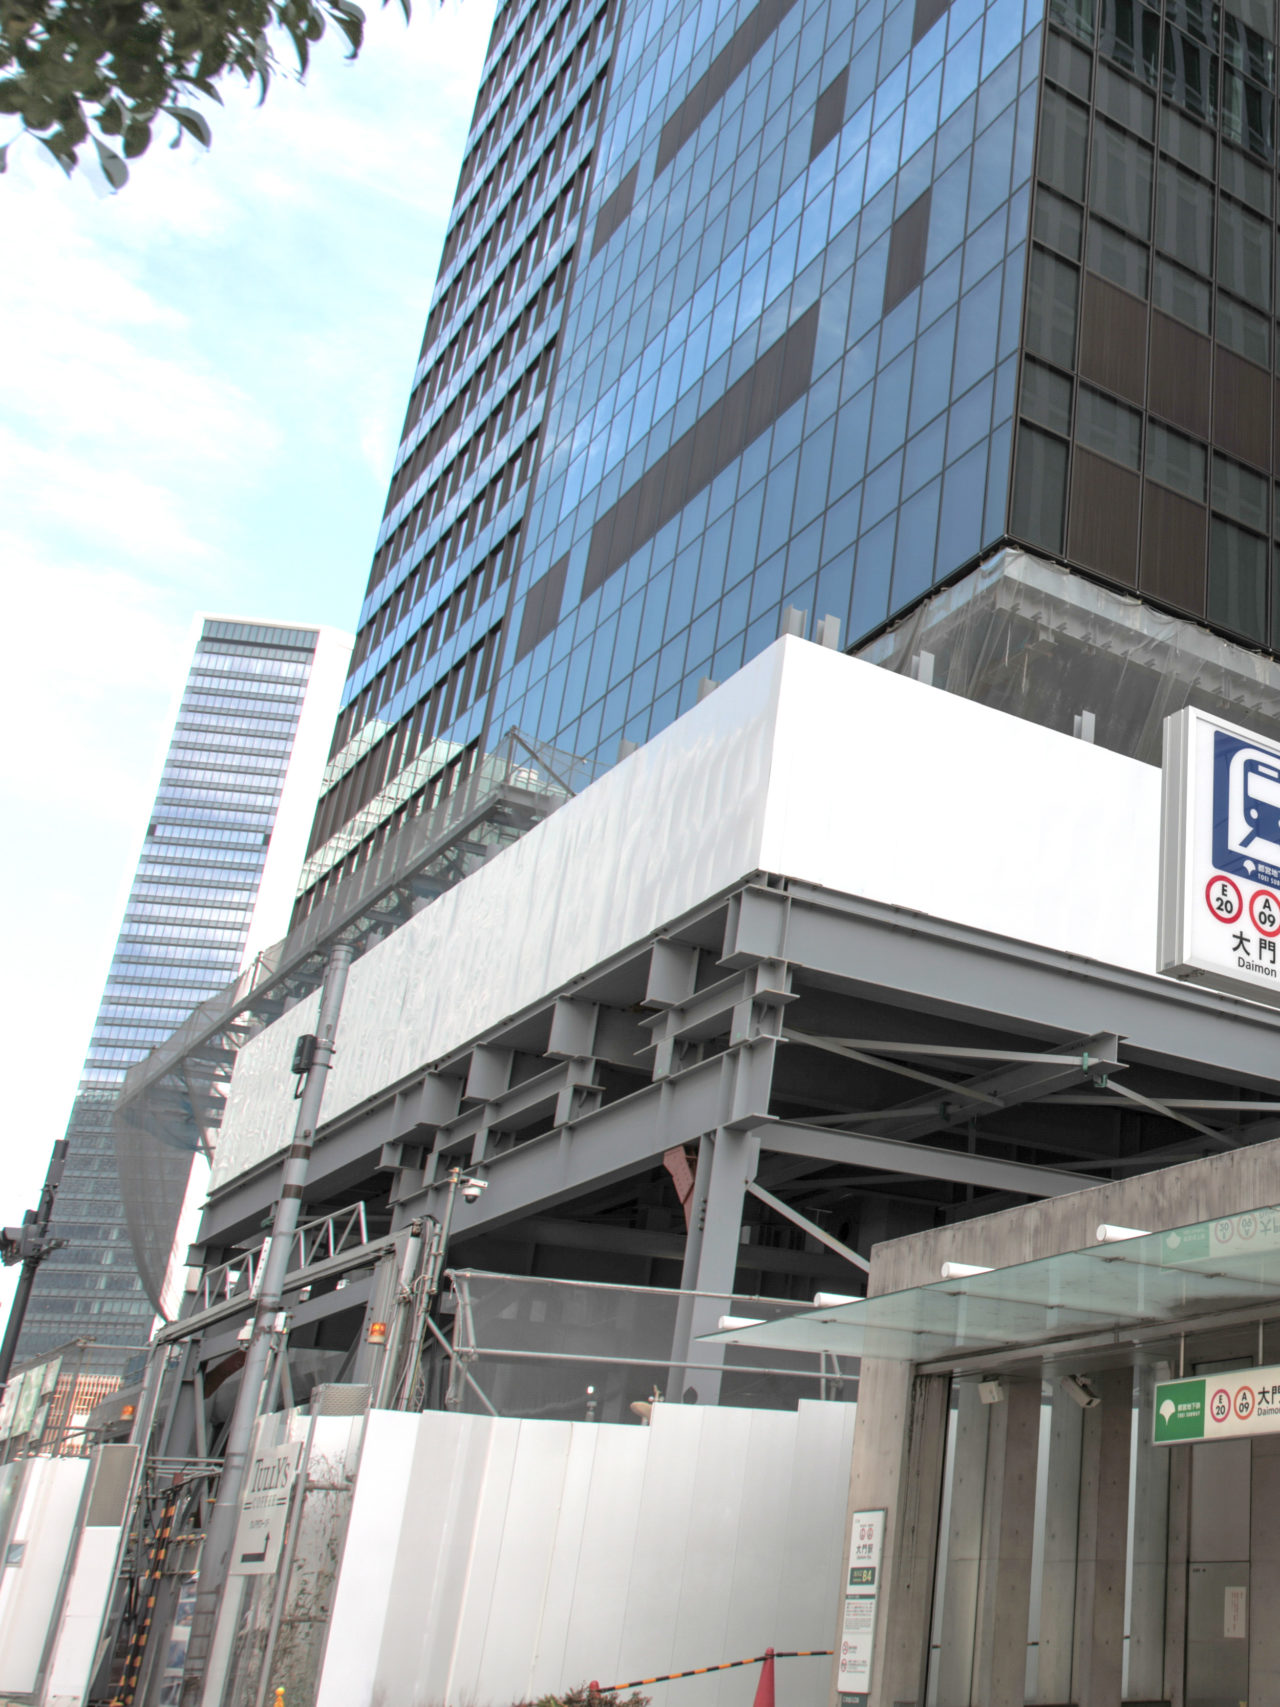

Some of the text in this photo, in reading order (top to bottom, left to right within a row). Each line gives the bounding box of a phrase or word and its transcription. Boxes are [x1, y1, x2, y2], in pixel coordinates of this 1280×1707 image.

[1257, 873, 1270, 883] TOEI
[1221, 883, 1228, 897] E
[1216, 897, 1234, 914] 20
[1262, 898, 1272, 912] A
[1258, 911, 1276, 927] 09
[1238, 956, 1277, 978] Daimon
[1218, 1395, 1223, 1404] E
[1242, 1392, 1248, 1401] A
[1215, 1405, 1226, 1415] 20
[1239, 1402, 1250, 1413] 09
